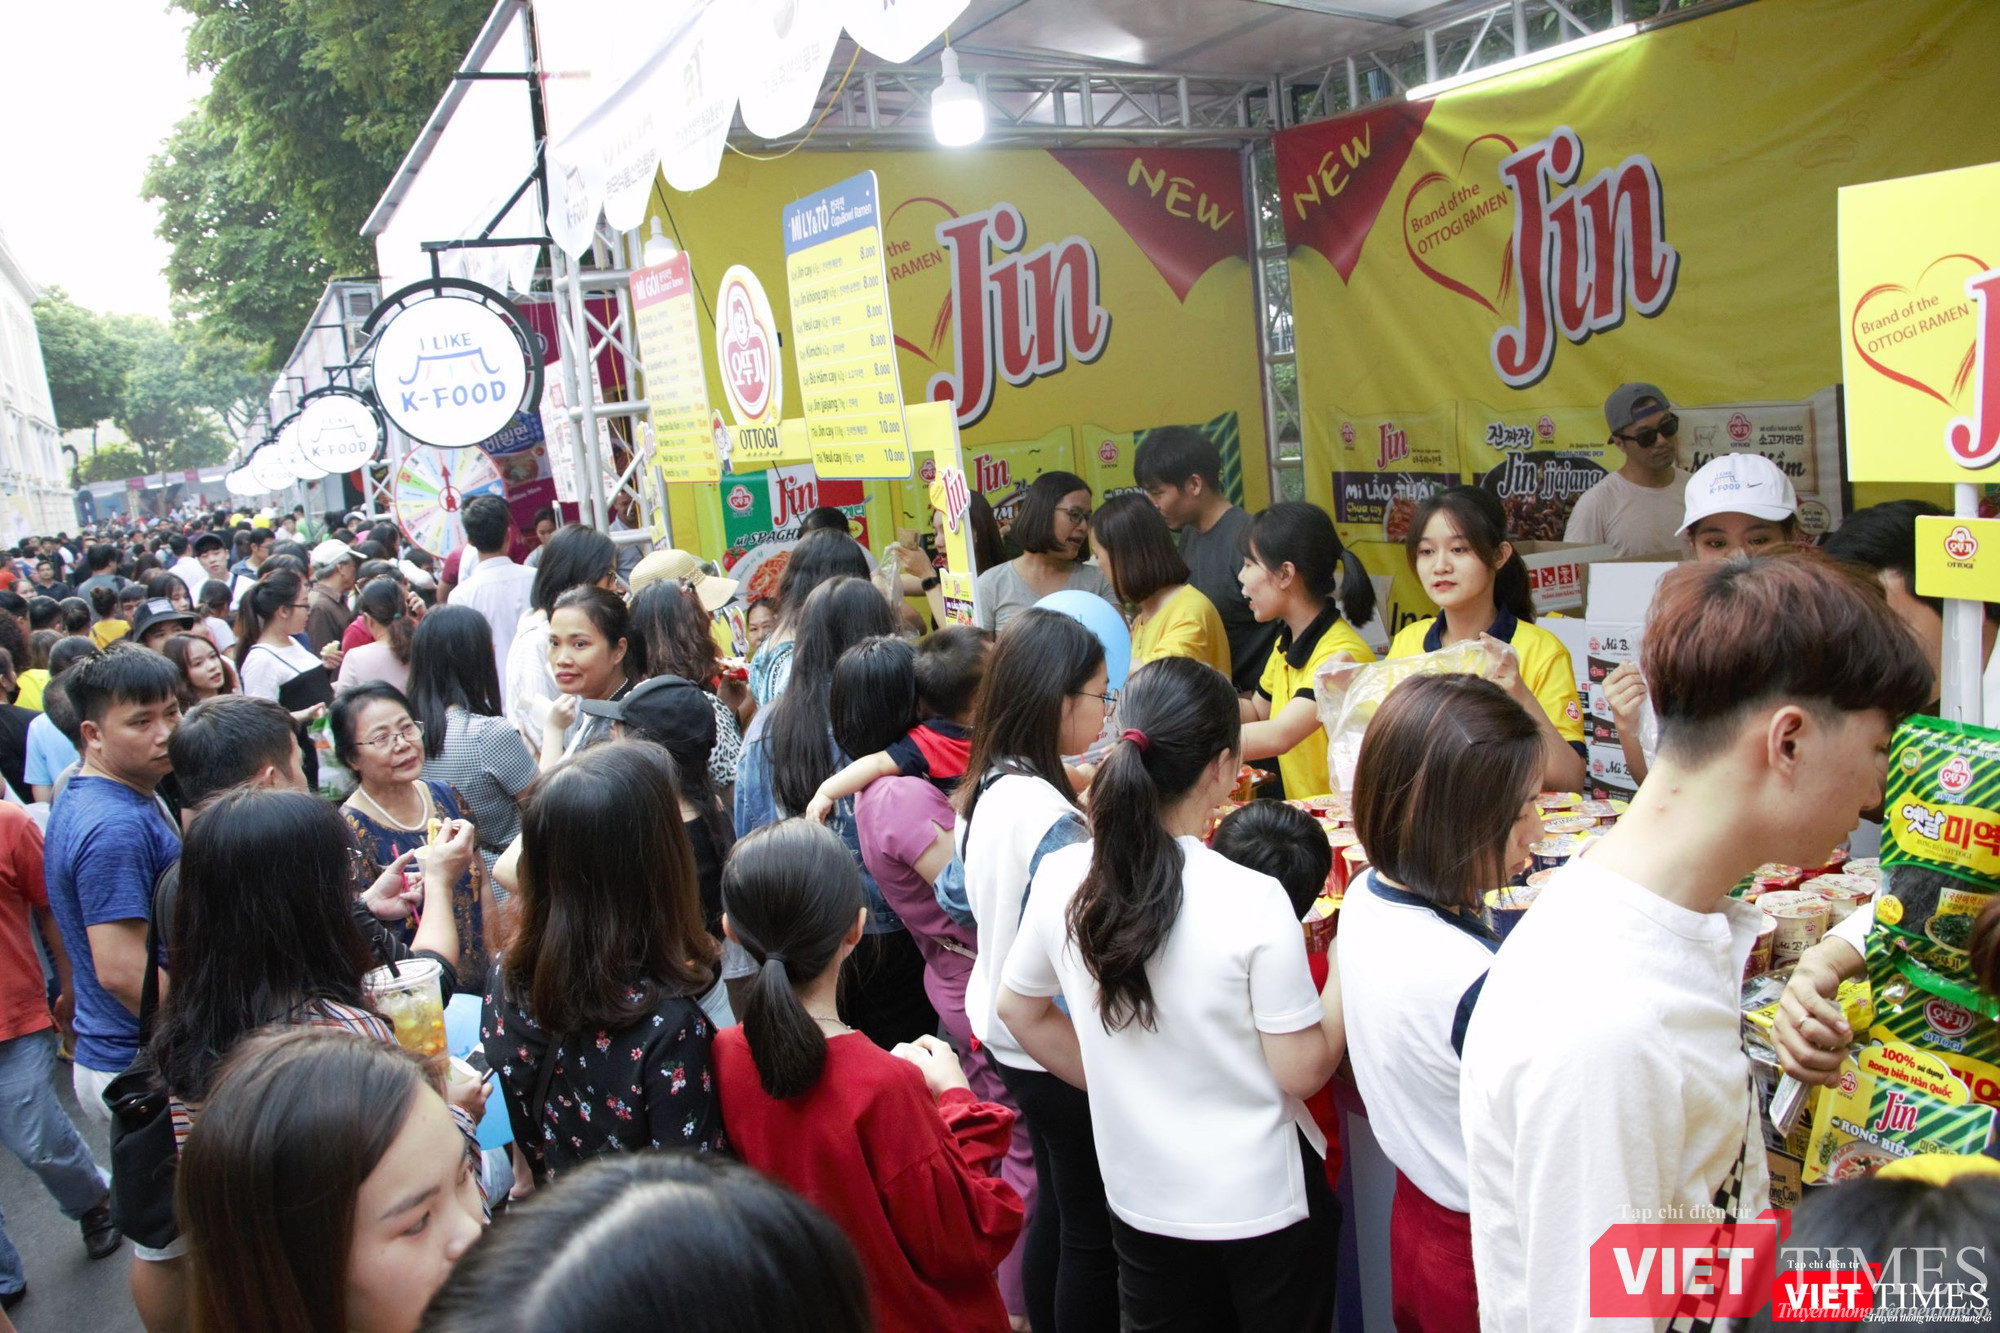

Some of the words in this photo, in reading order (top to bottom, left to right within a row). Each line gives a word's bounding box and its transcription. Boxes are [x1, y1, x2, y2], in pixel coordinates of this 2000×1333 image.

[1293, 121, 1372, 221] NEW
[1127, 157, 1234, 231] NEW
[1411, 203, 1448, 233] Brand
[1448, 192, 1459, 211] of
[1457, 182, 1480, 202] the
[1417, 218, 1464, 255] OTTOGI
[1461, 191, 1508, 231] RAMEN
[860, 245, 876, 259] 8.000
[886, 239, 911, 258] the
[1491, 125, 1681, 389] Jin
[889, 250, 943, 281] RAMEN
[863, 274, 879, 288] 8.000
[866, 304, 882, 318] 8.000
[928, 203, 1110, 424] Jin
[1861, 309, 1900, 335] Brand
[1901, 301, 1917, 318] of
[1919, 293, 1940, 313] the
[432, 332, 473, 350] LIKE
[870, 333, 886, 347] 8.000
[1868, 323, 1918, 354] OTTOGI
[1918, 303, 1970, 334] RAMEN
[874, 361, 891, 376] 8.000
[400, 380, 506, 413] K-FOOD
[878, 390, 895, 405] 8.000
[740, 427, 778, 450] OTTOGI
[880, 419, 901, 434] 10.000
[1487, 422, 1532, 448] 진짜장
[311, 441, 368, 457] K-FOOD
[1377, 421, 1408, 469] Jin
[1759, 434, 1804, 446] 소고기라면
[884, 448, 905, 463] 10.000
[973, 453, 1011, 495] Jin
[1499, 452, 1537, 498] Jin
[773, 475, 819, 527] Jin
[943, 468, 968, 532] Jin
[1605, 760, 1621, 774] Mì
[1943, 773, 1967, 784] 오뚜기
[1901, 804, 1947, 841] 옛날
[1943, 846, 1973, 860] OTTOGI
[1932, 1007, 1965, 1028] 오뚜기
[1922, 1031, 1964, 1052] OTTOGI
[1882, 1047, 1915, 1069] 100%
[1926, 1067, 1944, 1080] dụng
[1868, 1060, 1889, 1076] Rong
[1910, 1075, 1928, 1089] Hàn
[1929, 1084, 1953, 1098] Quốc
[1875, 1090, 1918, 1133] Jin
[1841, 1120, 1879, 1145] RONG
